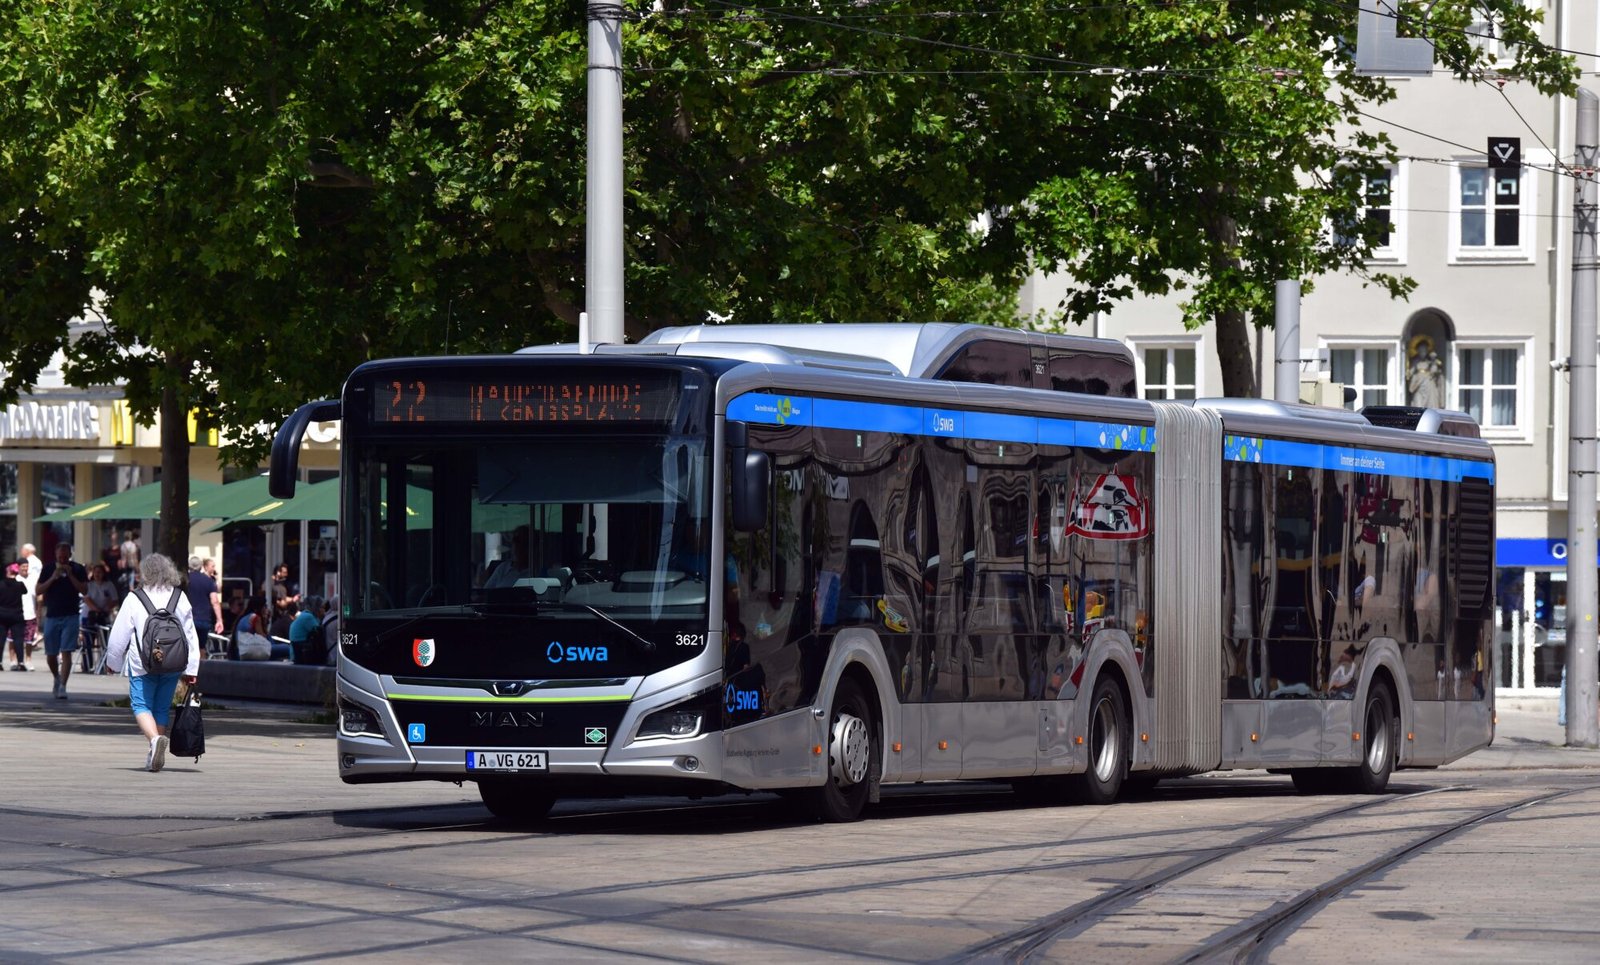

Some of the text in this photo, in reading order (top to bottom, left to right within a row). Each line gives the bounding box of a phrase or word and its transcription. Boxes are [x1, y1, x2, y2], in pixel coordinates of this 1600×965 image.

[386, 381, 426, 422] 22
[471, 385, 641, 403] HAUPBAHNHO
[1340, 452, 1354, 467] Immer
[1361, 455, 1374, 469] deiner
[1374, 457, 1385, 470] Seite
[341, 633, 358, 645] 3621
[675, 634, 704, 646] 3621
[566, 646, 608, 662] swa
[736, 690, 759, 710] swa
[470, 711, 544, 727] MAN
[478, 753, 542, 768] A VG 621
